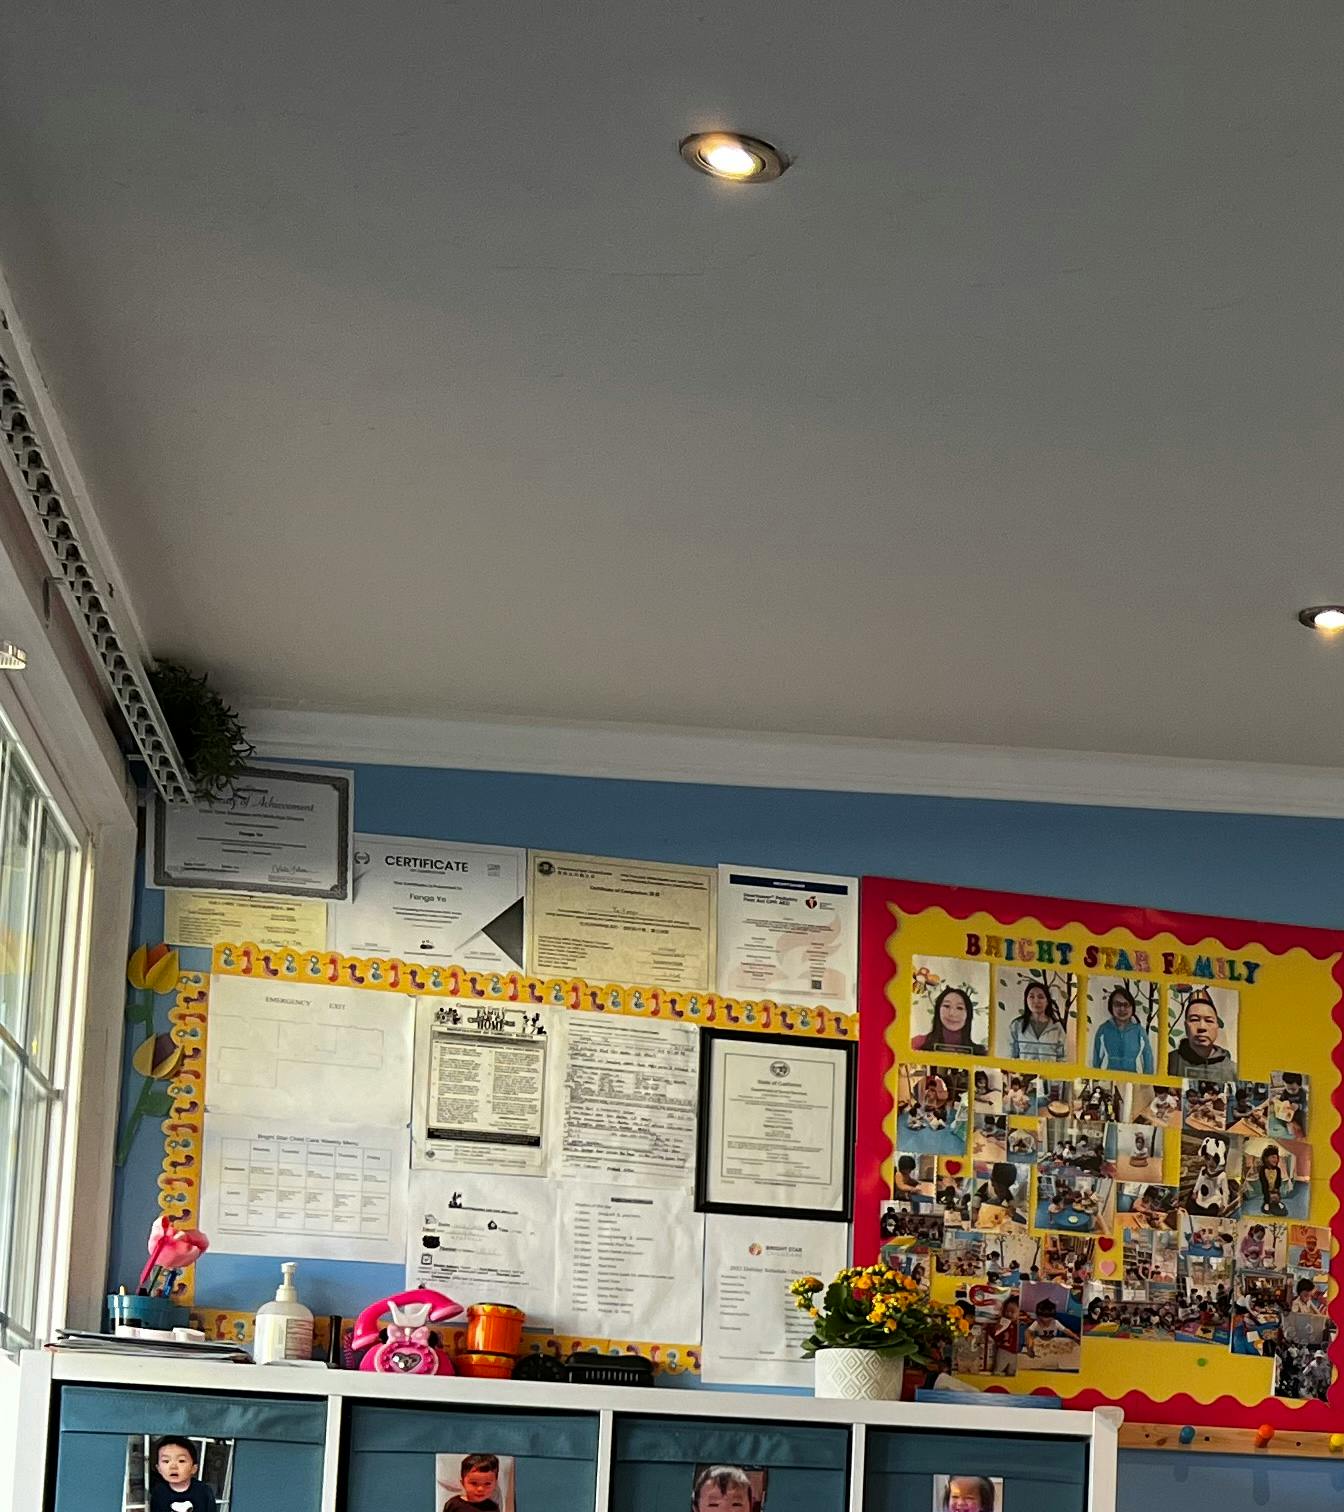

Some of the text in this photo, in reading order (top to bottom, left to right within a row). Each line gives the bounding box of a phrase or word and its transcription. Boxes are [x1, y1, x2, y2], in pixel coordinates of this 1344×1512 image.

[384, 855, 470, 873] CERTIFICATE
[965, 933, 1262, 985] BRIGHT STAR FAMILY
[265, 996, 346, 1010] EMERGENCY EXIT
